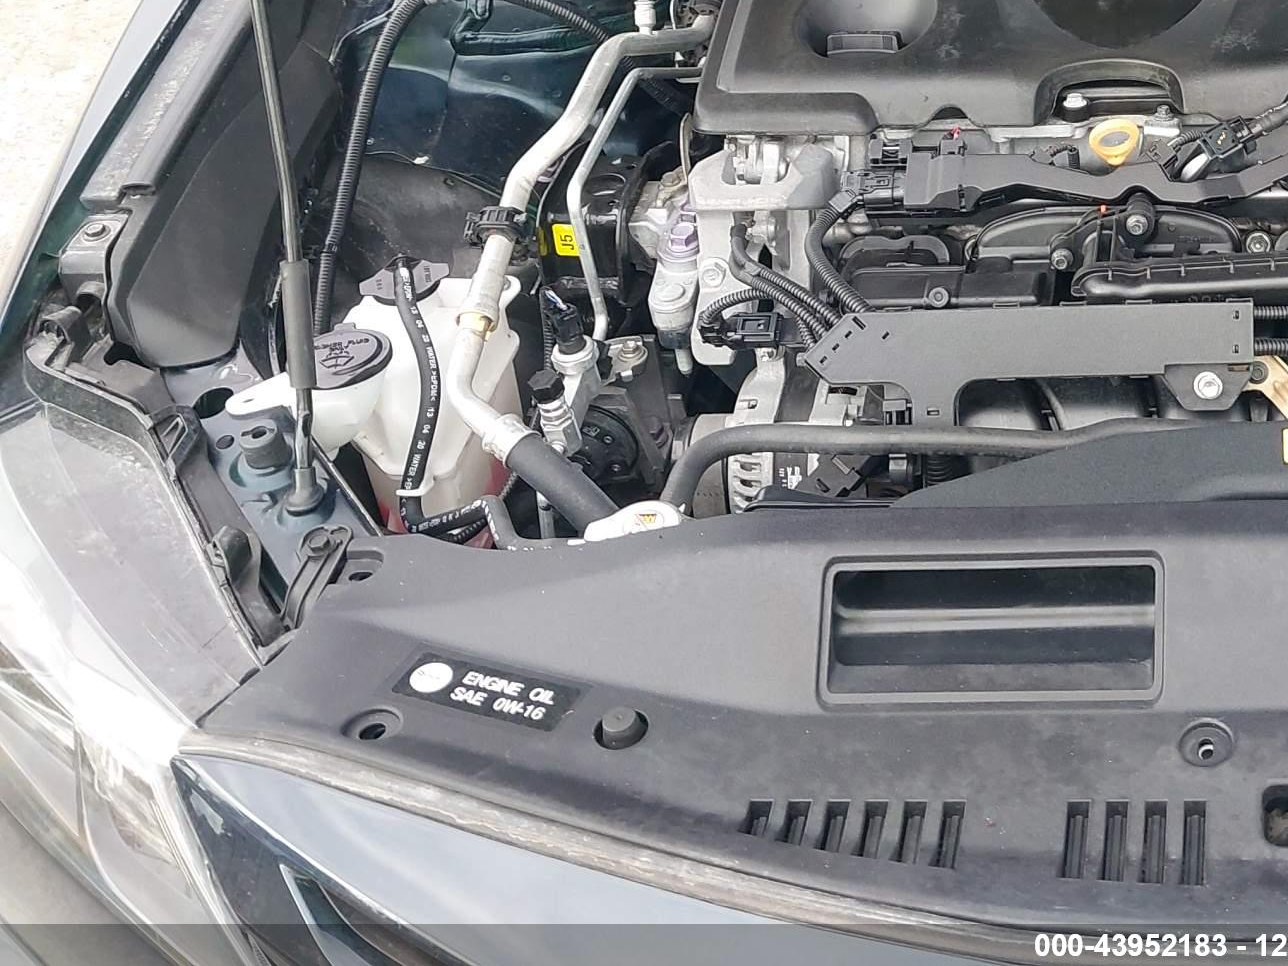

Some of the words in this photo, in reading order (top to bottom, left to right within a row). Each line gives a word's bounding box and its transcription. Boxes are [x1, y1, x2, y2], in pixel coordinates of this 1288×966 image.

[346, 337, 370, 346] FLUID
[426, 346, 437, 369] WATER
[407, 453, 422, 476] WATER
[462, 671, 525, 697] ENGINE
[528, 686, 556, 706] OIL
[450, 687, 488, 707] SAE
[492, 697, 547, 721] 0W-16
